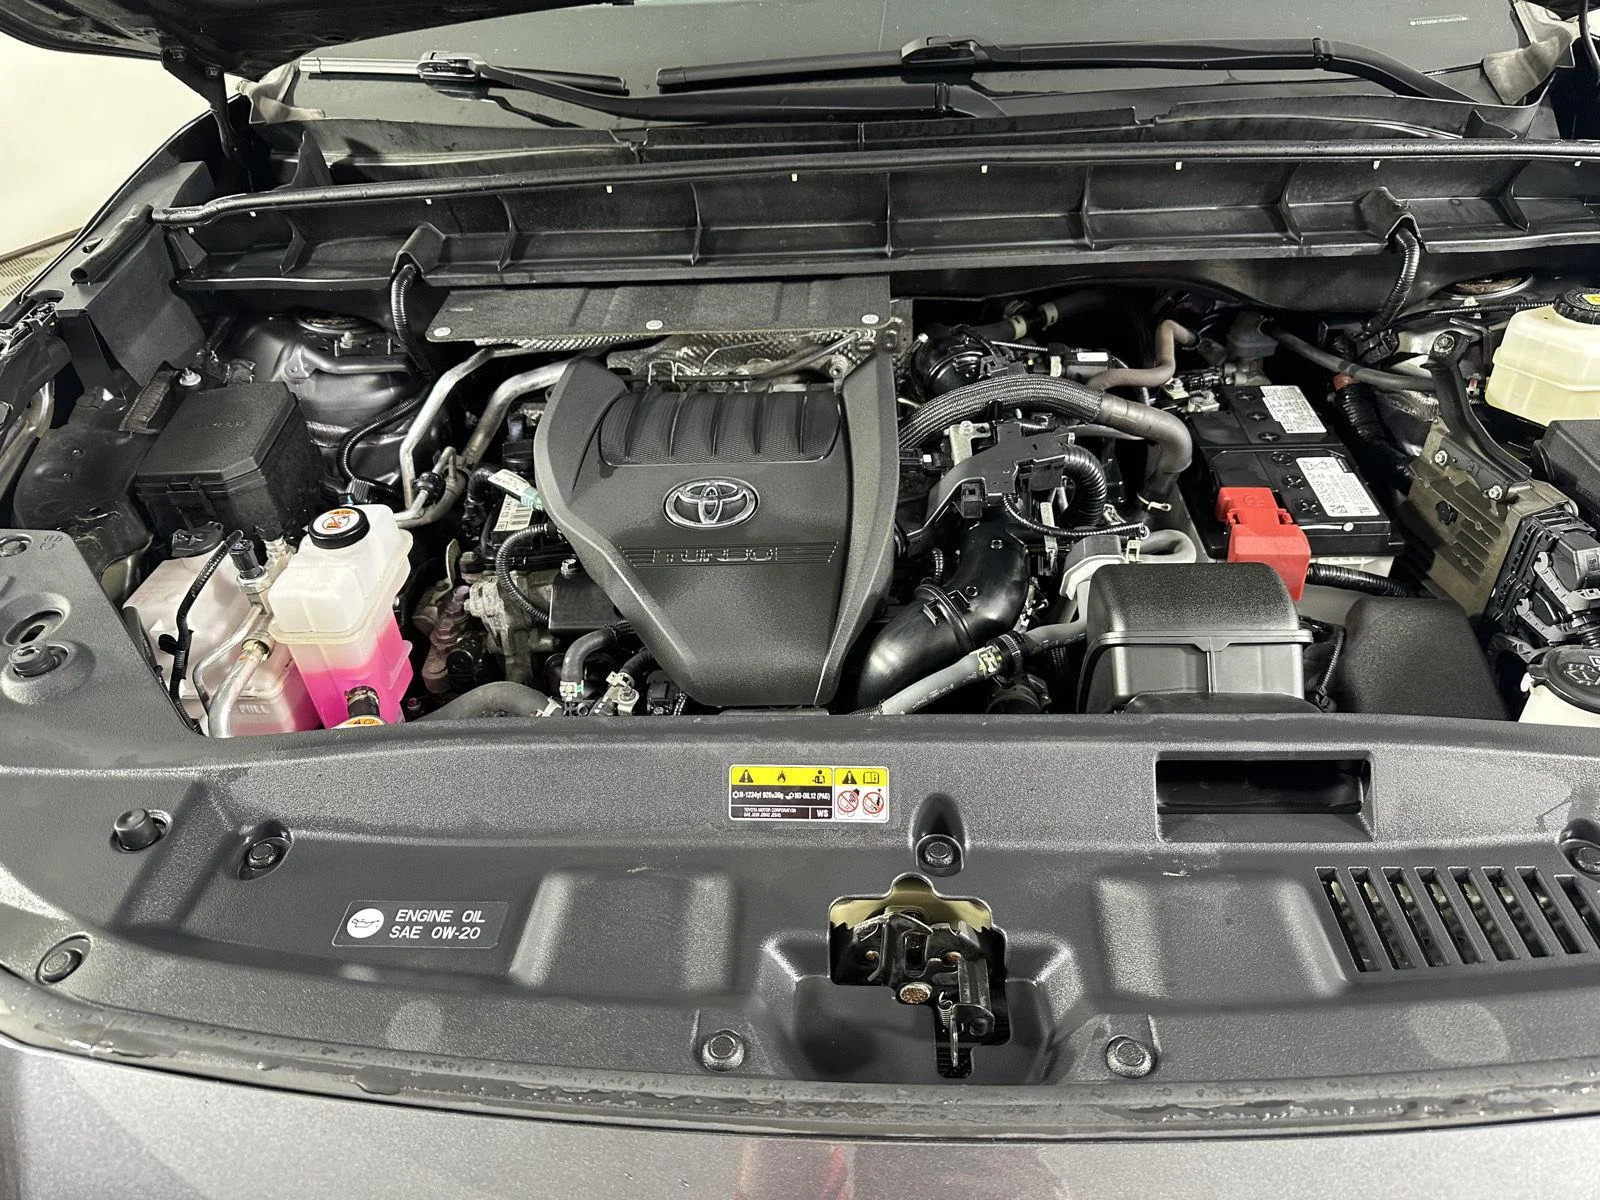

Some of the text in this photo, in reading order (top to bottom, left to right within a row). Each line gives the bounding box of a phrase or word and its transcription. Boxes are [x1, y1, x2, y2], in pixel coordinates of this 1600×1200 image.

[238, 704, 270, 714] FULL
[816, 809, 829, 818] WS
[394, 909, 486, 923] ENGINE OIL
[389, 925, 423, 939] SAE
